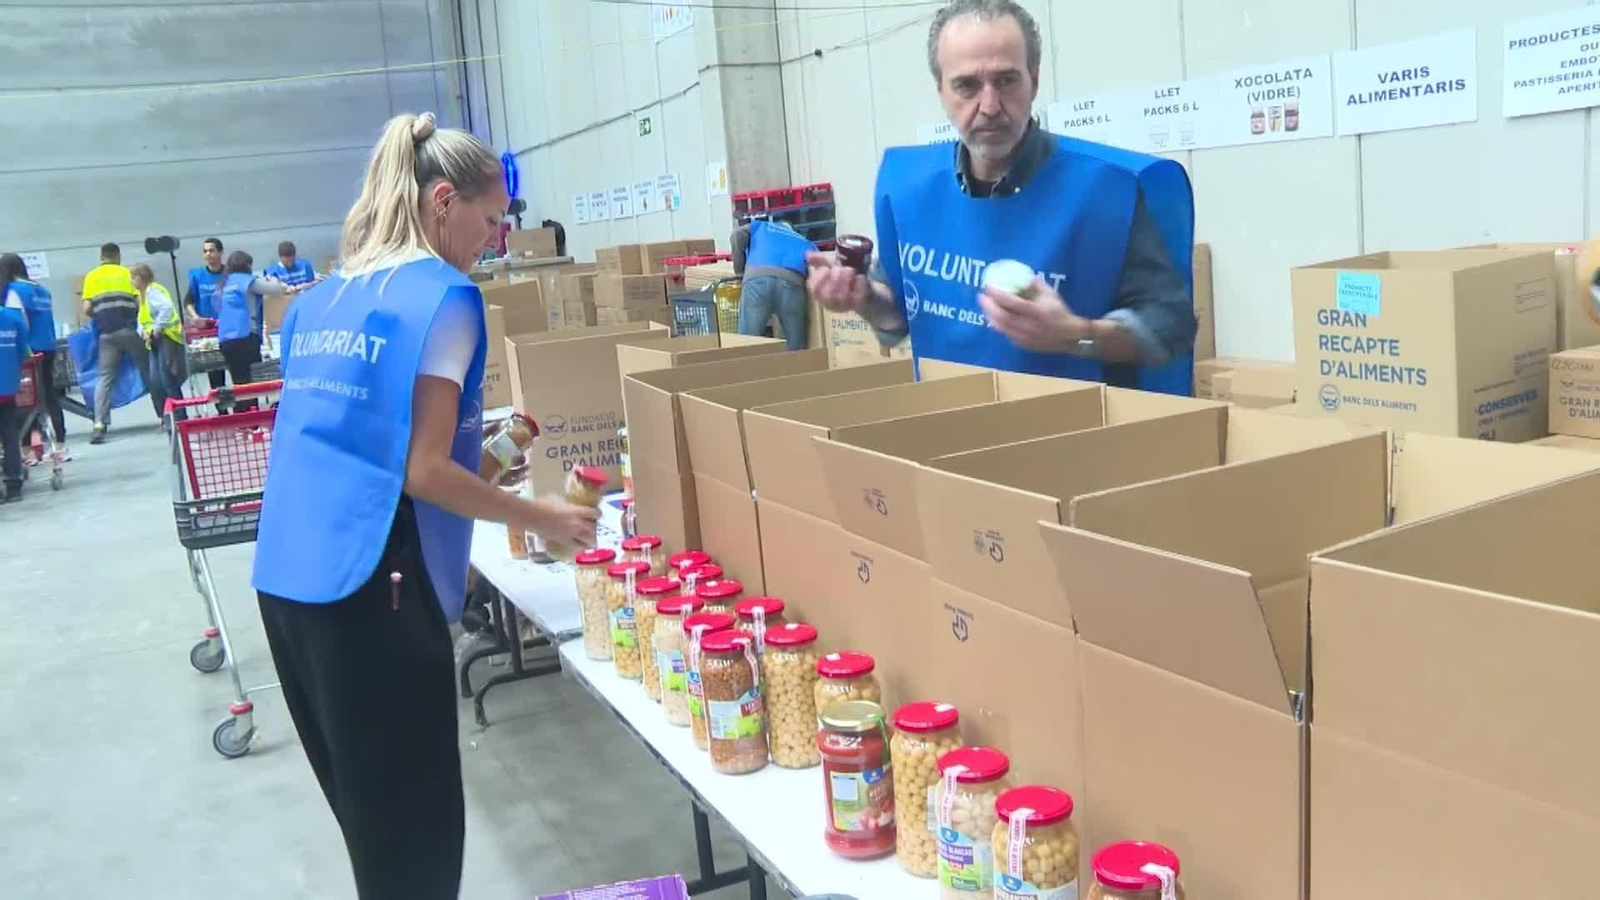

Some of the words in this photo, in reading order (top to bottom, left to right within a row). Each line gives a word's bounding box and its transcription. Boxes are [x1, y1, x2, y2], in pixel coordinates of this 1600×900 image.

[1508, 23, 1600, 50] PRODUCTES
[1235, 67, 1314, 89] XOCOLATA
[1377, 65, 1431, 85] VARIS
[1513, 69, 1593, 89] PASTISSERIA
[1154, 86, 1182, 100] LLET
[1247, 86, 1302, 105] (VIDRE)
[1346, 78, 1467, 107] ALIMENTARIS
[1073, 100, 1096, 113] LLET
[1143, 103, 1180, 118] PACKS
[1064, 115, 1095, 129] PACKS
[898, 240, 1066, 294] VOLUNTAT
[922, 299, 955, 320] BANC
[958, 308, 985, 327] DELS
[1317, 308, 1367, 328] GRAN
[291, 329, 387, 364] OLUNTARIAT
[1319, 333, 1400, 357] RECAPTE
[1320, 358, 1427, 387] D'ALIMENTS
[546, 441, 593, 460] GRAN
